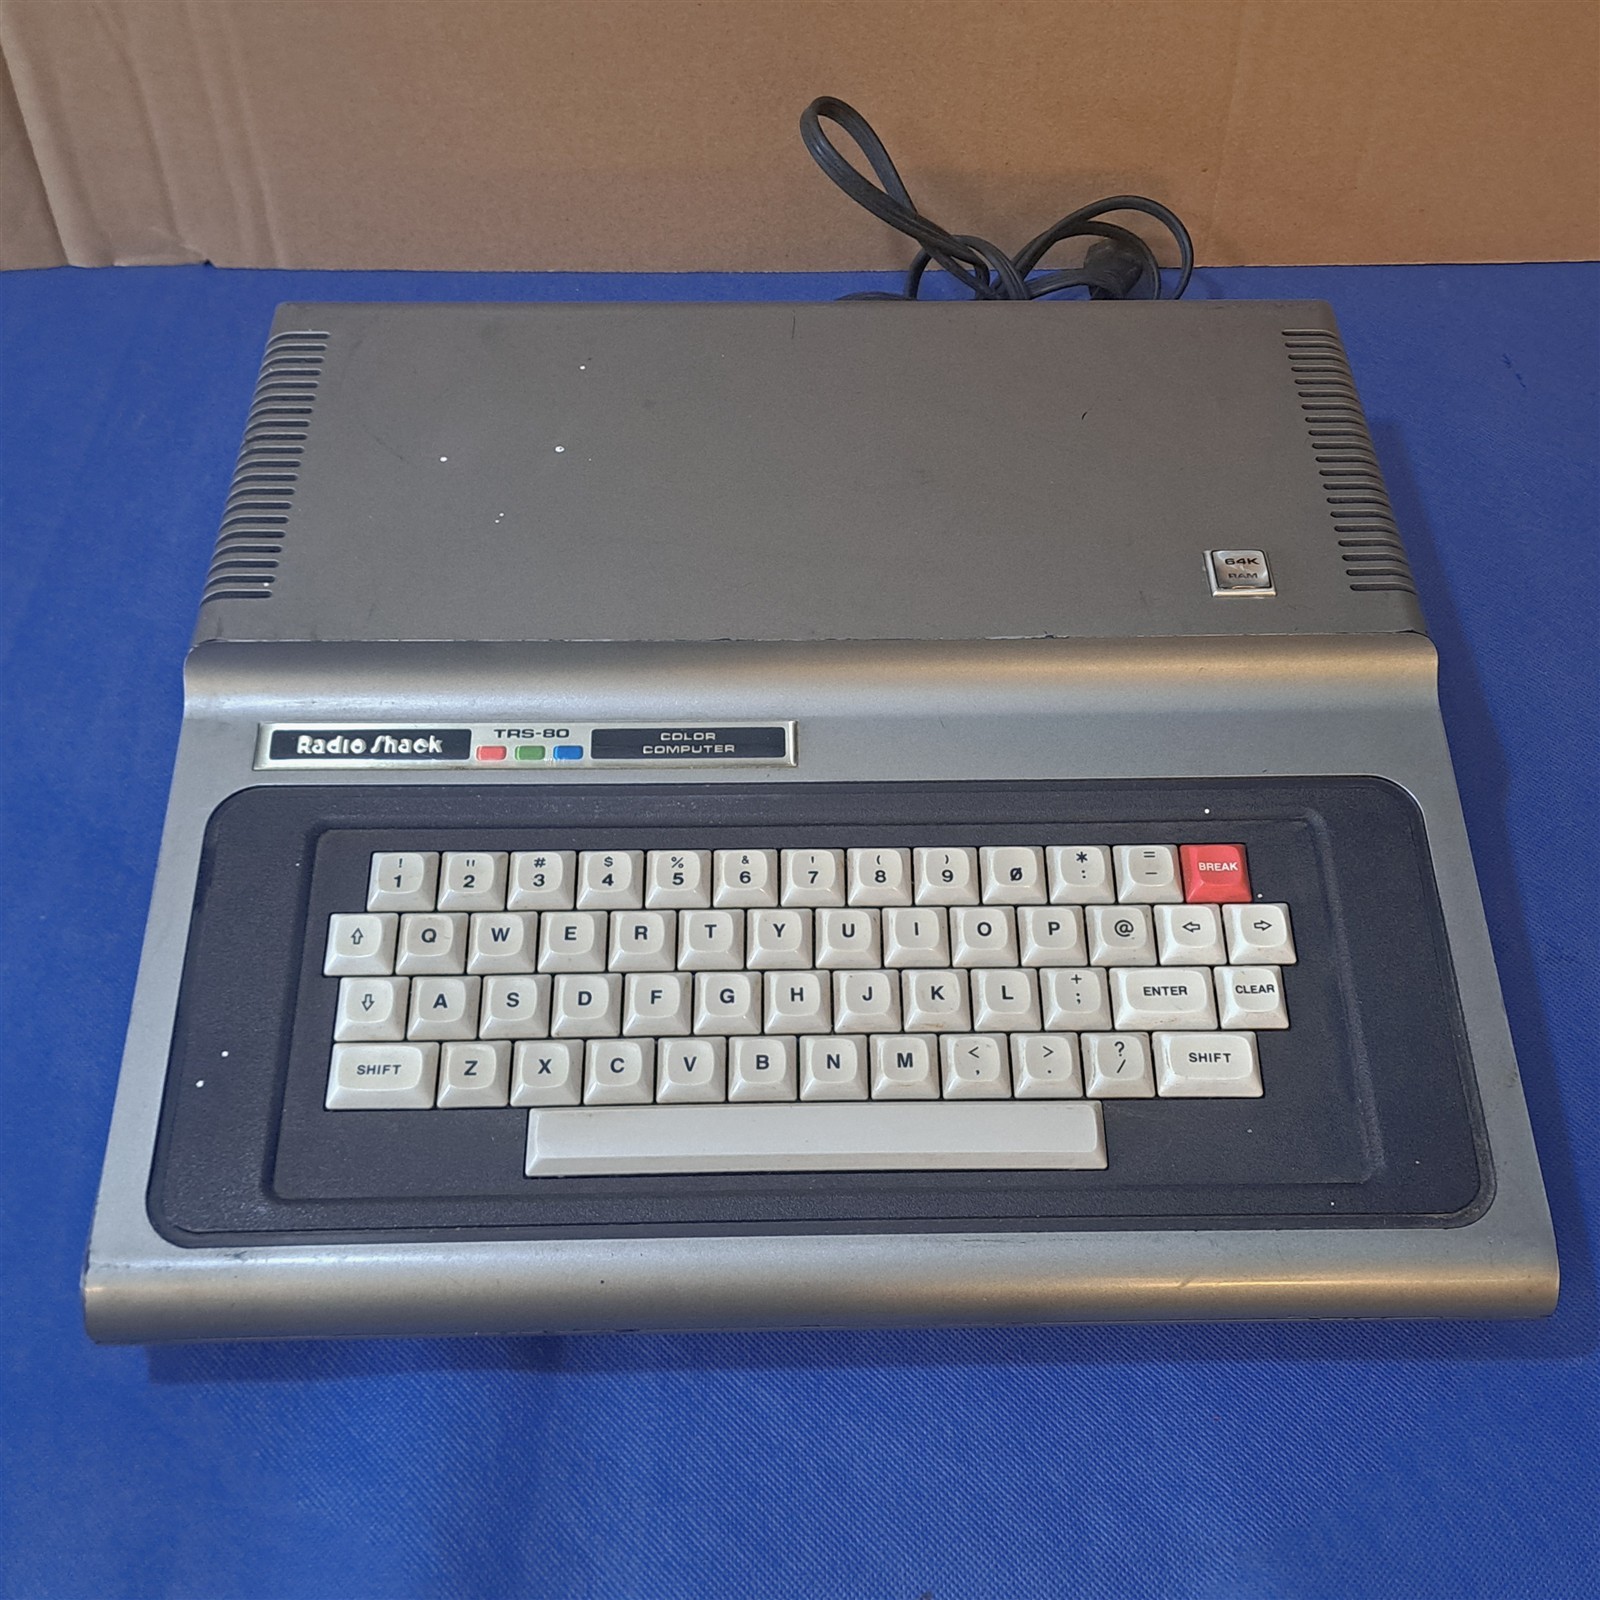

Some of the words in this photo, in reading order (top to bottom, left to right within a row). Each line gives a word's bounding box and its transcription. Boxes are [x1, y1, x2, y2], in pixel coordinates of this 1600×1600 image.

[494, 728, 570, 738] TRS-80
[660, 732, 716, 740] COLOR
[297, 735, 366, 754] Radio
[370, 735, 443, 753] Shack
[642, 744, 735, 754] COMPUTER
[398, 857, 403, 869] !
[534, 858, 545, 868] #
[604, 857, 613, 867] $
[671, 857, 684, 868] %
[742, 856, 749, 864] &
[877, 855, 880, 865] (
[945, 855, 949, 864] )
[1199, 862, 1238, 871] BREAK
[394, 875, 401, 887] 1
[463, 875, 474, 888] 2
[533, 874, 545, 887] 3
[602, 874, 613, 886] 4
[673, 873, 684, 885] 5
[740, 871, 751, 883] 6
[808, 871, 818, 883] 7
[875, 870, 886, 883] 8
[942, 870, 953, 882] 9
[491, 928, 510, 942] W
[565, 927, 577, 940] E
[635, 926, 647, 940] R
[705, 925, 716, 938] T
[773, 924, 785, 937] Y
[842, 924, 854, 937] U
[915, 922, 918, 935] I
[977, 922, 991, 936] O
[1048, 922, 1060, 935] P
[1114, 920, 1133, 937] @
[422, 929, 436, 943] Q
[1071, 975, 1081, 984] +
[791, 987, 803, 1001] H
[862, 987, 872, 1001] J
[931, 986, 944, 1000] K
[1002, 986, 1013, 999] L
[1144, 986, 1187, 996] ENTER
[1235, 984, 1274, 994] CLEAR
[433, 994, 447, 1008] A
[507, 992, 519, 1007] S
[578, 991, 592, 1005] D
[651, 990, 662, 1004] F
[720, 989, 734, 1003] G
[968, 1047, 979, 1058] <
[1043, 1046, 1053, 1057] >
[1115, 1041, 1124, 1056] ?
[756, 1055, 769, 1069] B
[827, 1054, 840, 1069] N
[897, 1053, 913, 1068] M
[1189, 1053, 1231, 1062] SHIFT
[357, 1065, 401, 1075] SHIFT
[464, 1061, 477, 1075] Z
[538, 1059, 551, 1074] X
[611, 1058, 624, 1073] C
[684, 1057, 696, 1072] V
[1117, 1060, 1126, 1073] /
